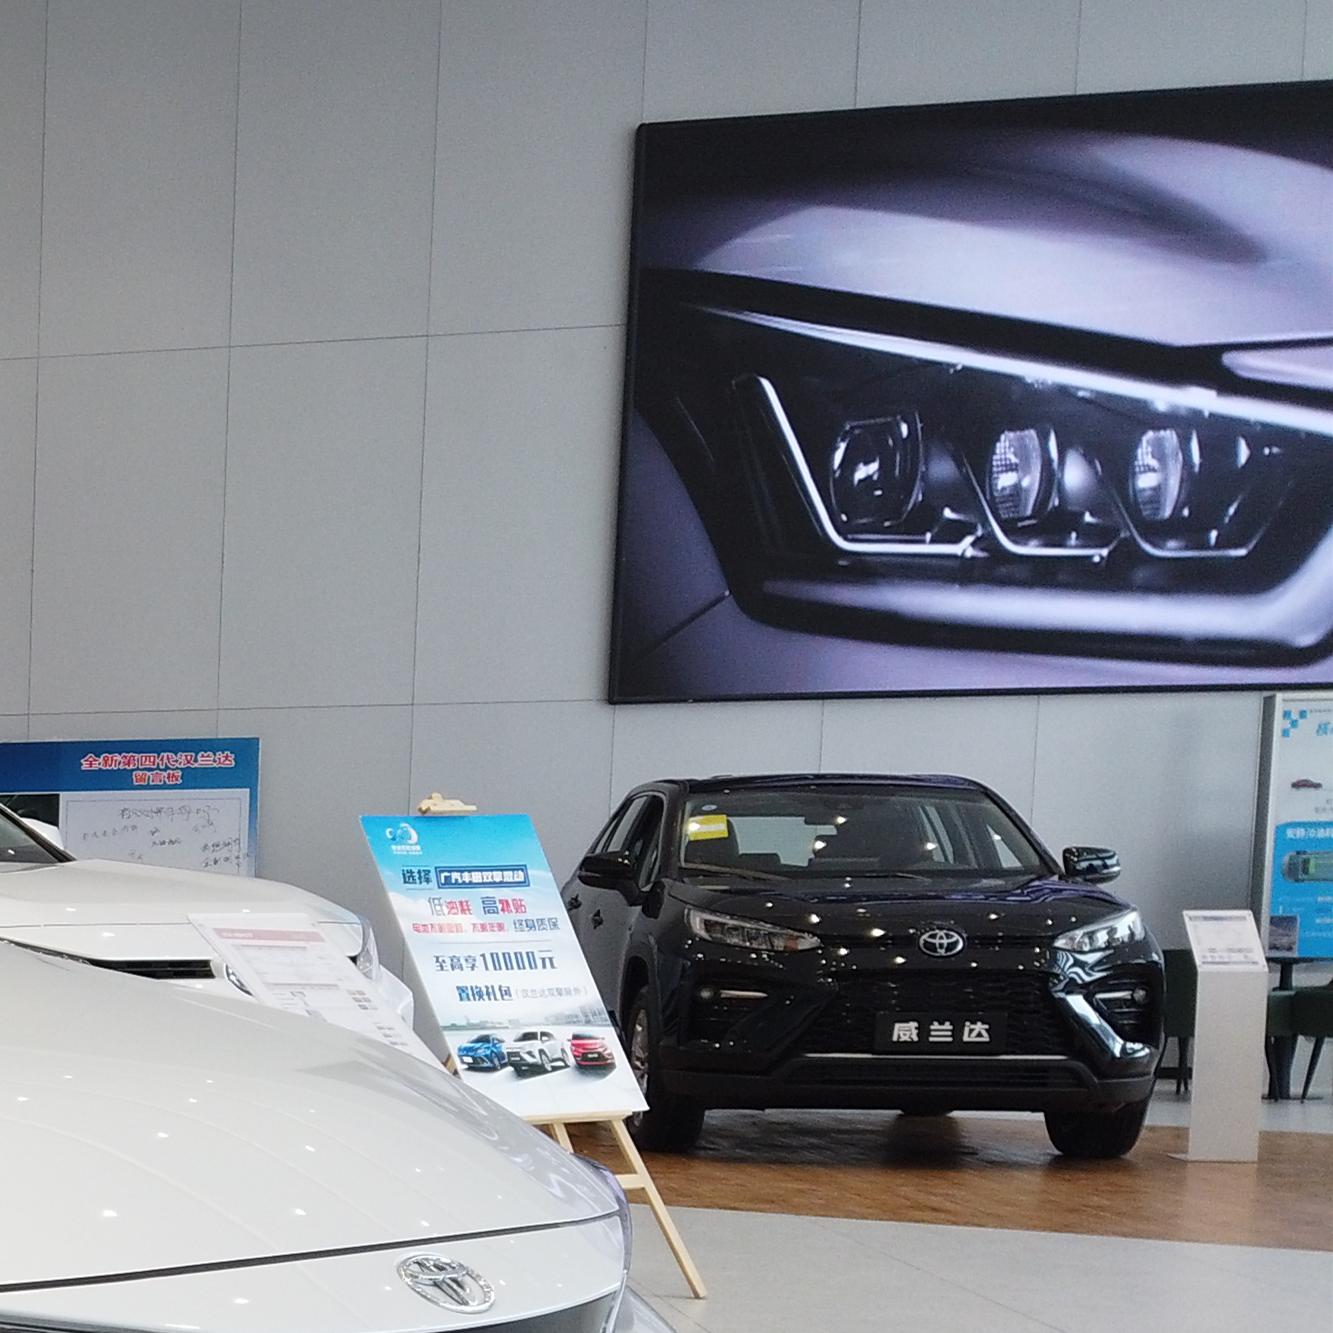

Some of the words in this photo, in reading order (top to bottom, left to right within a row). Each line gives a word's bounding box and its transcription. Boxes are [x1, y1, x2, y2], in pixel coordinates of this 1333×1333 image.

[81, 752, 235, 770] 全新第四代汉兰达
[132, 771, 182, 785] 留言板
[401, 869, 433, 885] 选择
[428, 897, 473, 916] 低油耗
[481, 896, 527, 915] 高补贴
[434, 950, 557, 972] 至高享10000元
[455, 985, 514, 1002] 置换礼包
[892, 1021, 991, 1042] 威兰达
